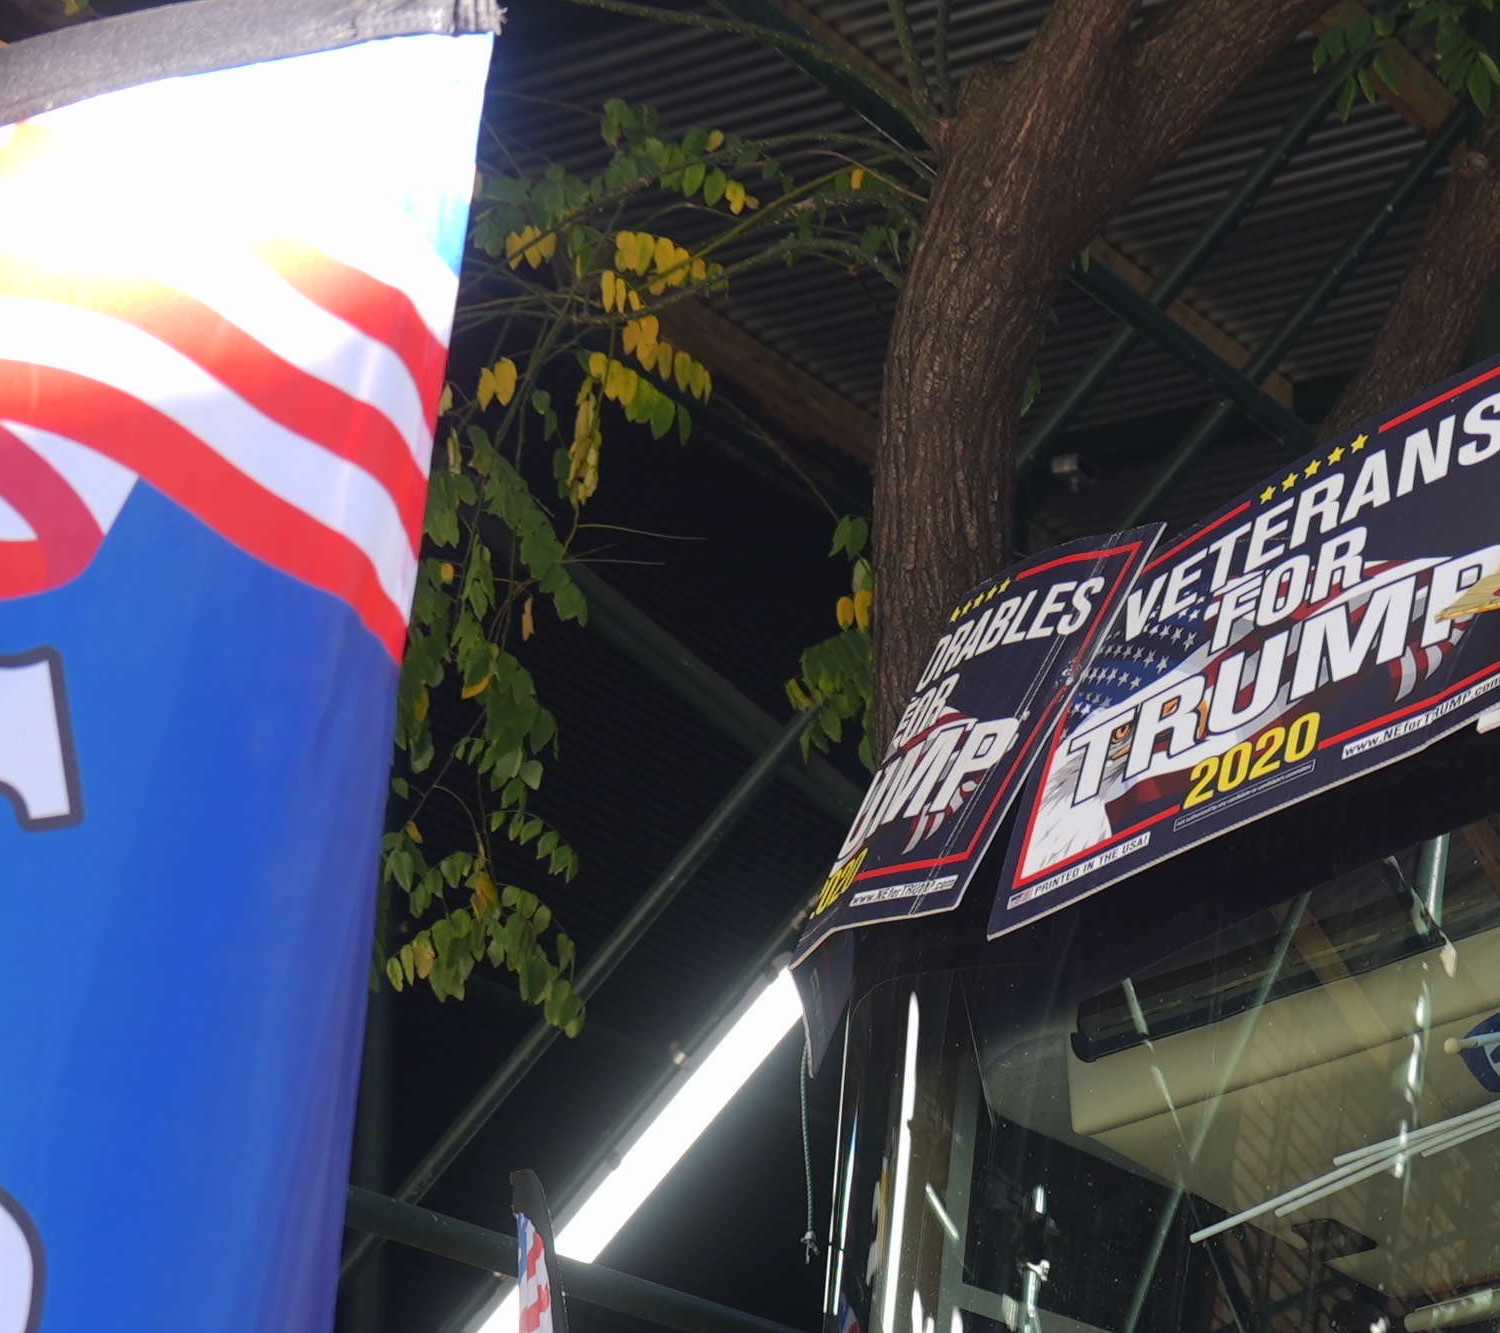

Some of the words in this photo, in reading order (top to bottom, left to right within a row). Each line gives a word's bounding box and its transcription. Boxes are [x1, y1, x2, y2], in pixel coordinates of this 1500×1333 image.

[1206, 526, 1370, 653] FOR
[1182, 712, 1320, 810] 2020
[1034, 868, 1080, 897] PRINTED
[1082, 860, 1095, 876] IN
[1097, 850, 1120, 869] THE
[1121, 835, 1148, 860] USA!
